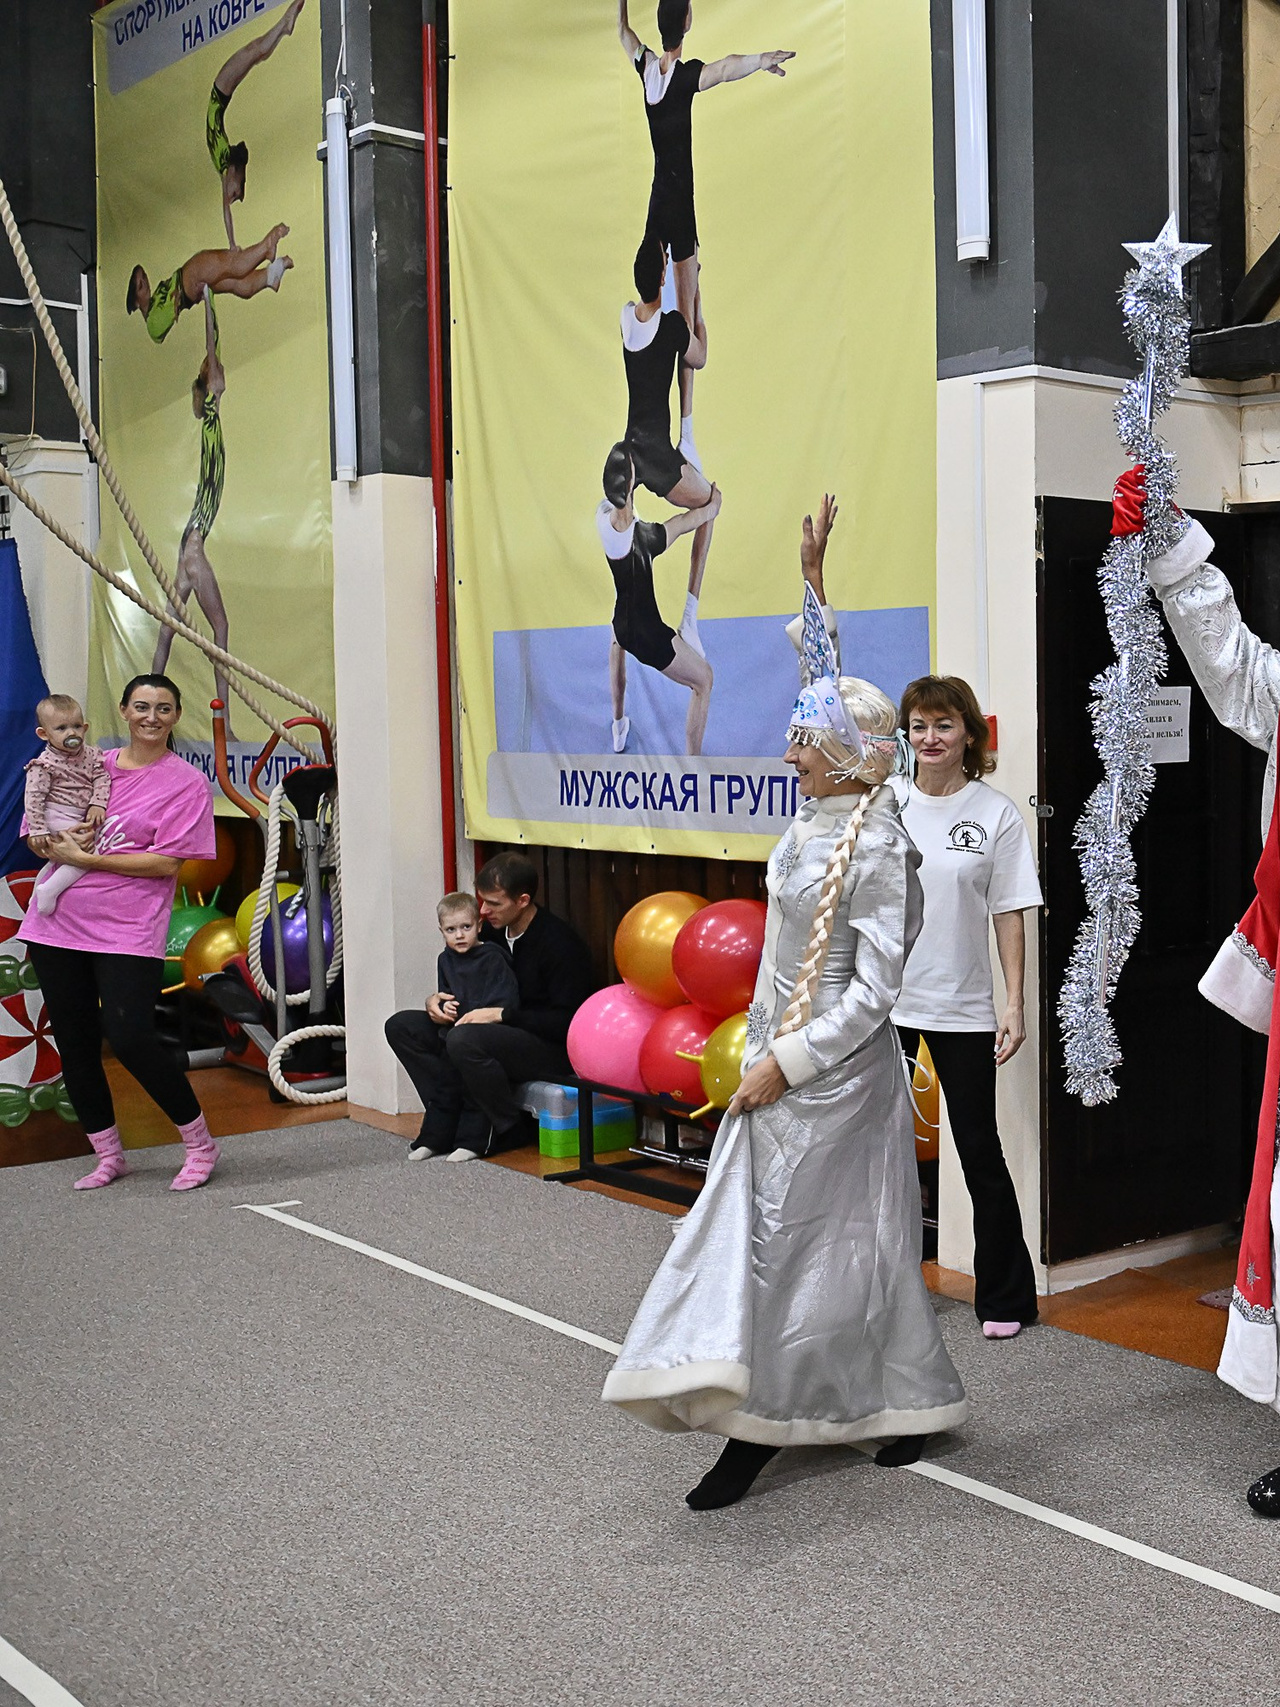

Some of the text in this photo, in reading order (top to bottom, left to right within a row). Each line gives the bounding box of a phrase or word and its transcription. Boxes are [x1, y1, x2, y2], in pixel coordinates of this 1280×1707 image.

[114, 0, 196, 46] СПОРТИ
[182, 14, 204, 52] НА
[559, 769, 811, 817] МУЖСКАЯ ГРУПП
